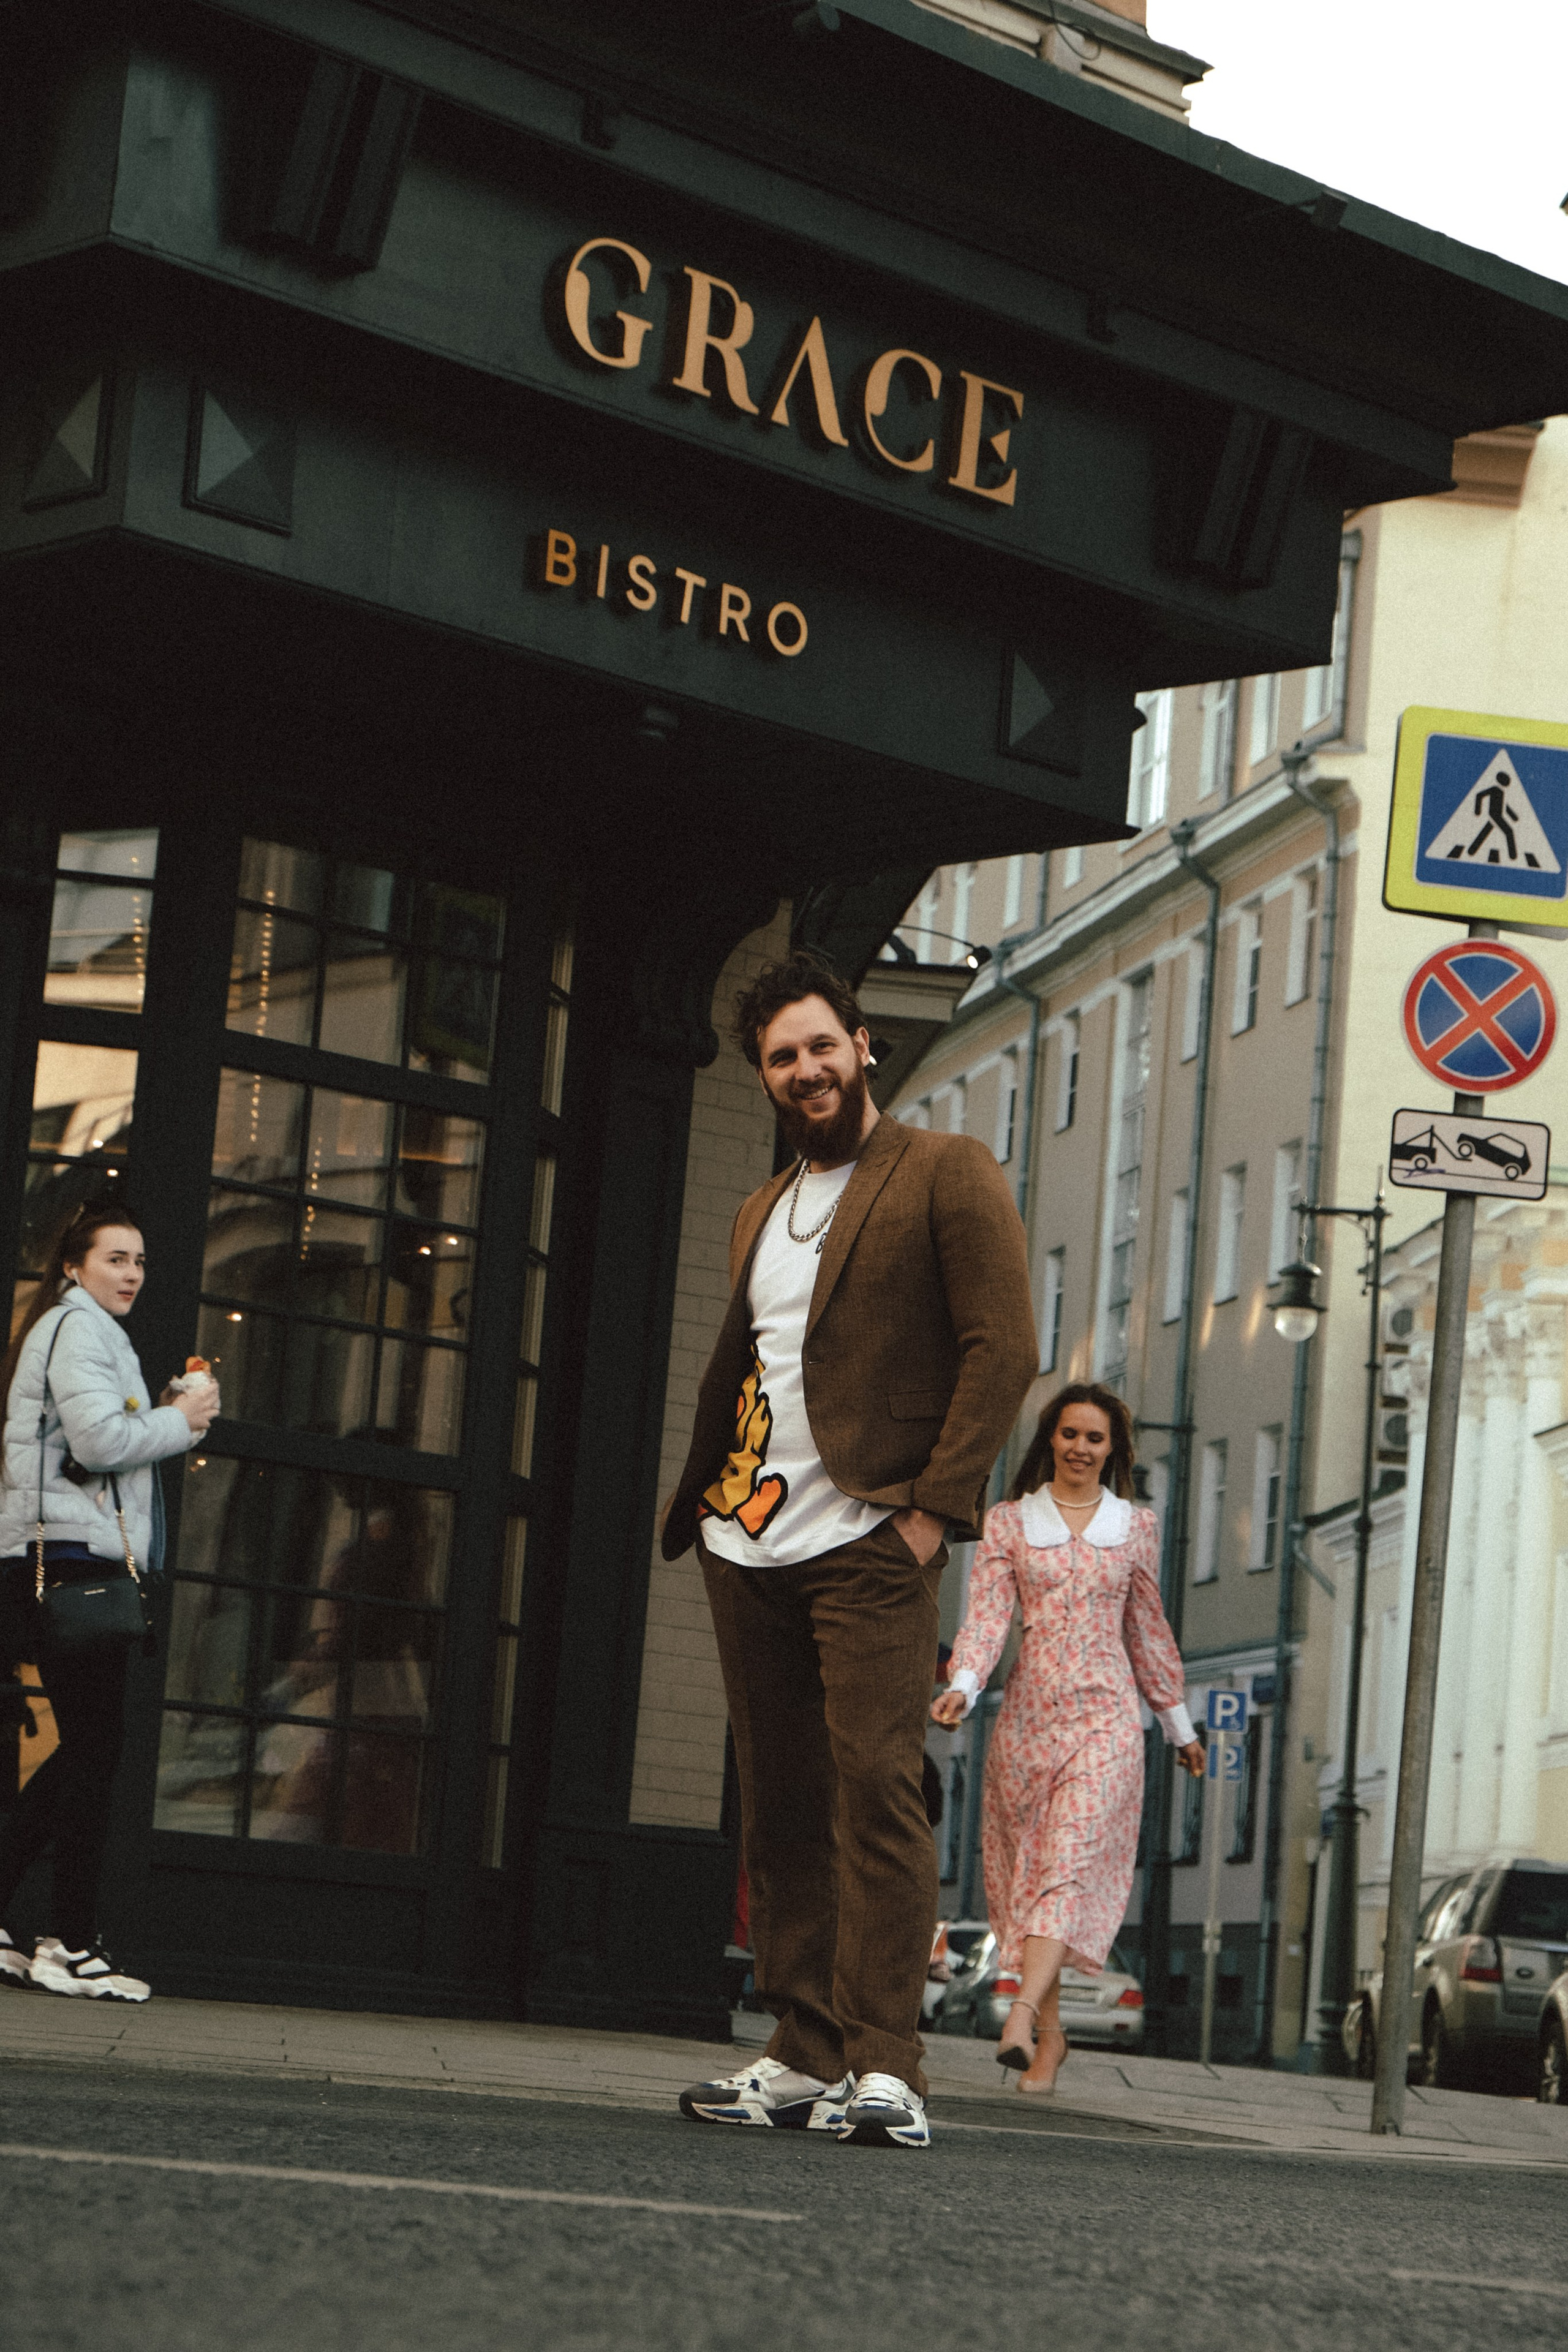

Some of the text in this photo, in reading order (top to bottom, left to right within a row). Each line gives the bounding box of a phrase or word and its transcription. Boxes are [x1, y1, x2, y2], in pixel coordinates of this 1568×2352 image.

[565, 237, 1023, 506] GRACE
[545, 529, 808, 656] BISTRO
[1215, 1693, 1239, 1727] P
